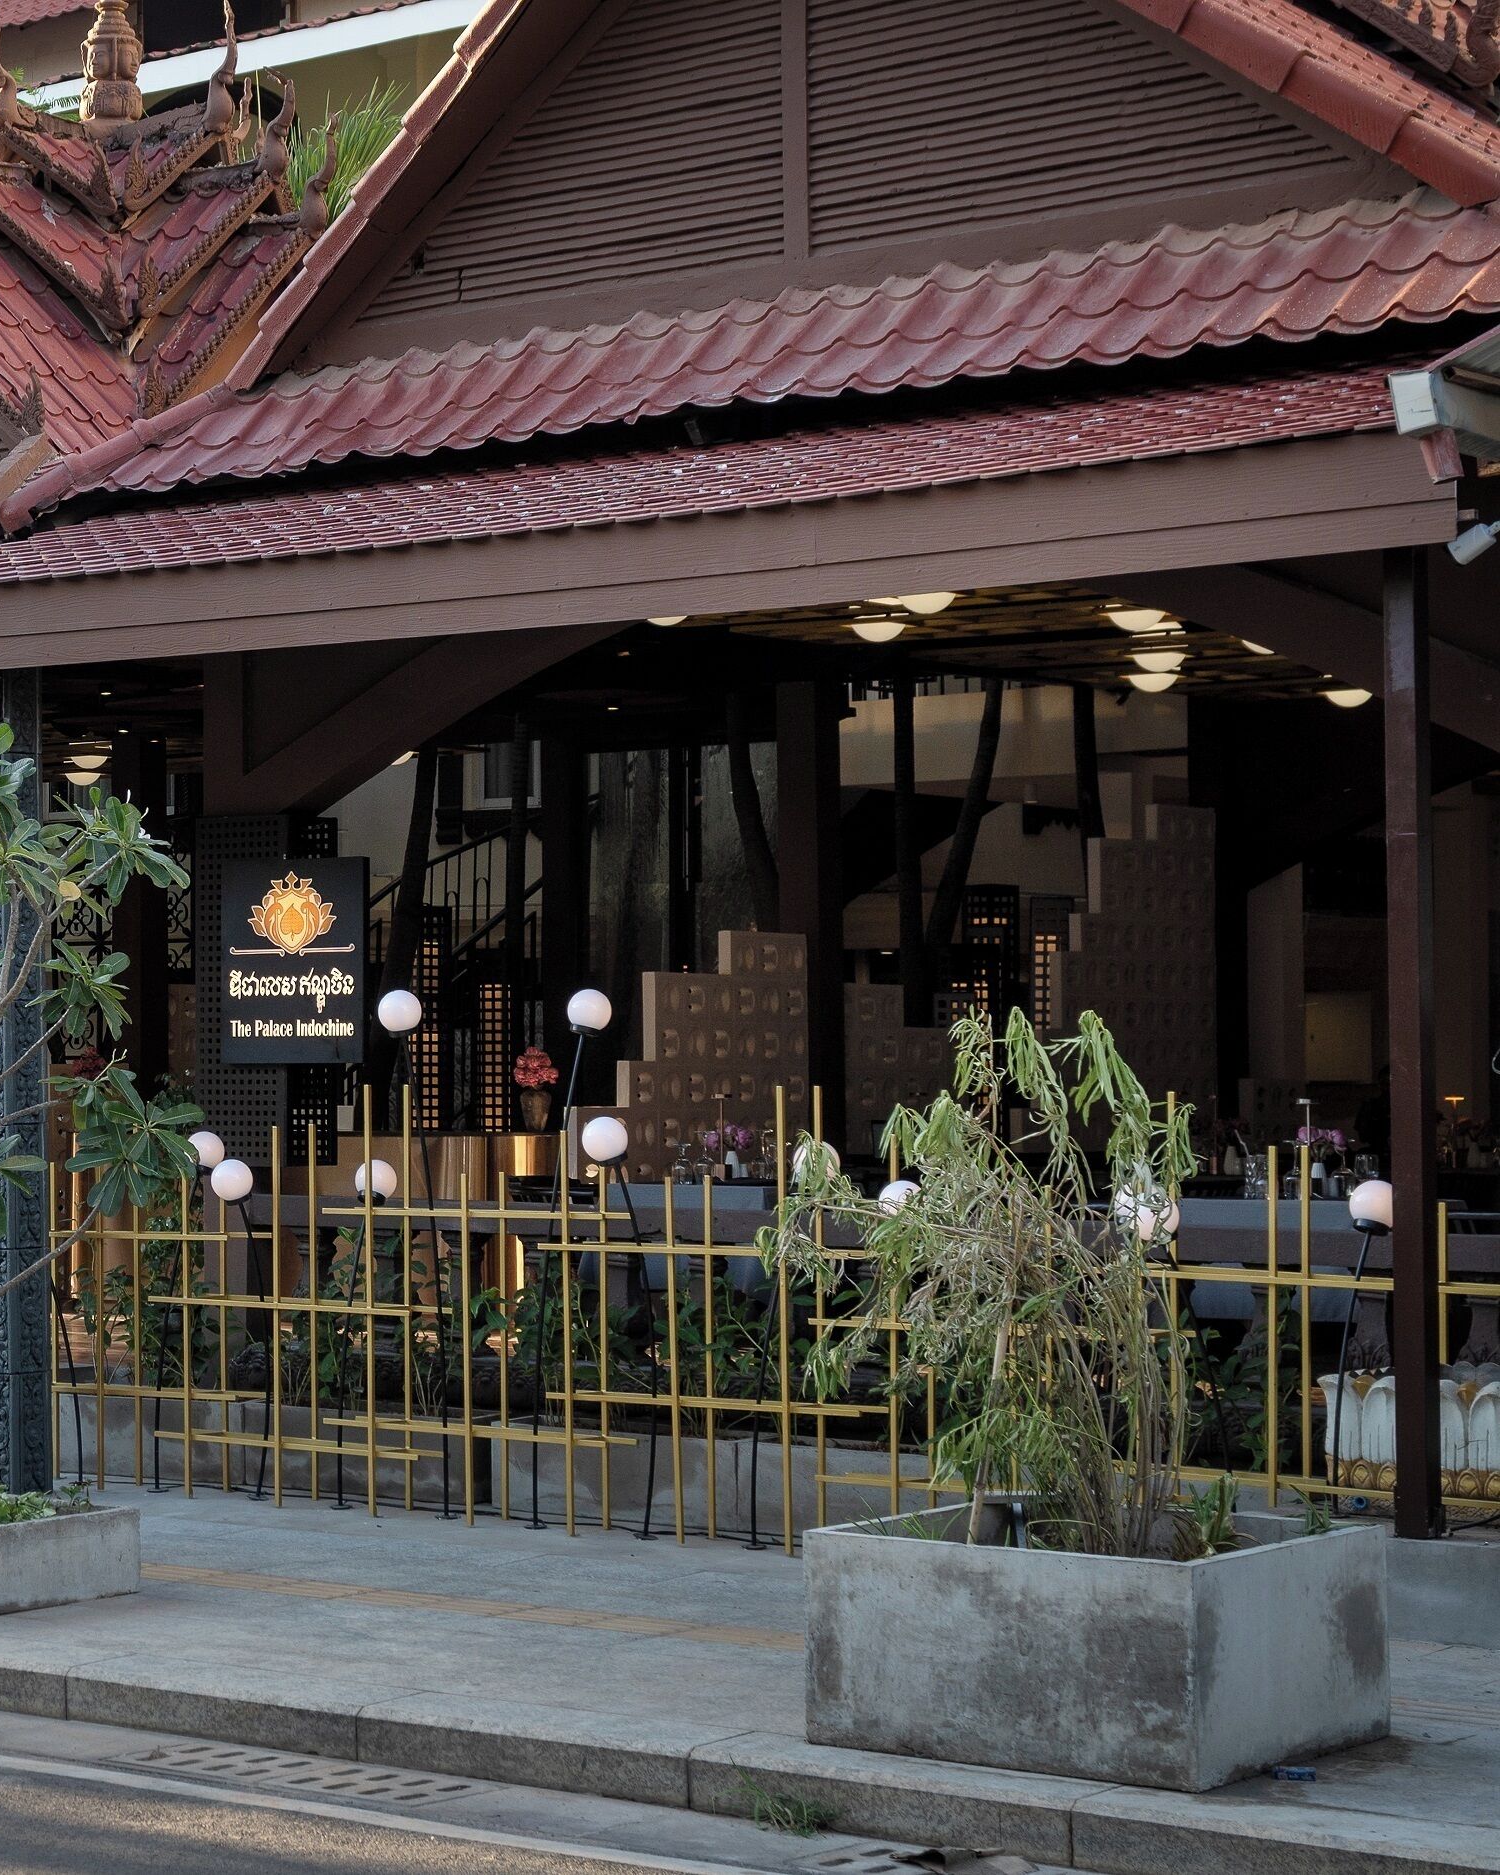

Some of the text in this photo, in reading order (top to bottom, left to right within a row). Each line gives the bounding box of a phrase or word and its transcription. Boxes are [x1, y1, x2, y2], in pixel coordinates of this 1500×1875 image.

[230, 1018, 355, 1037] The Palace Indochine
